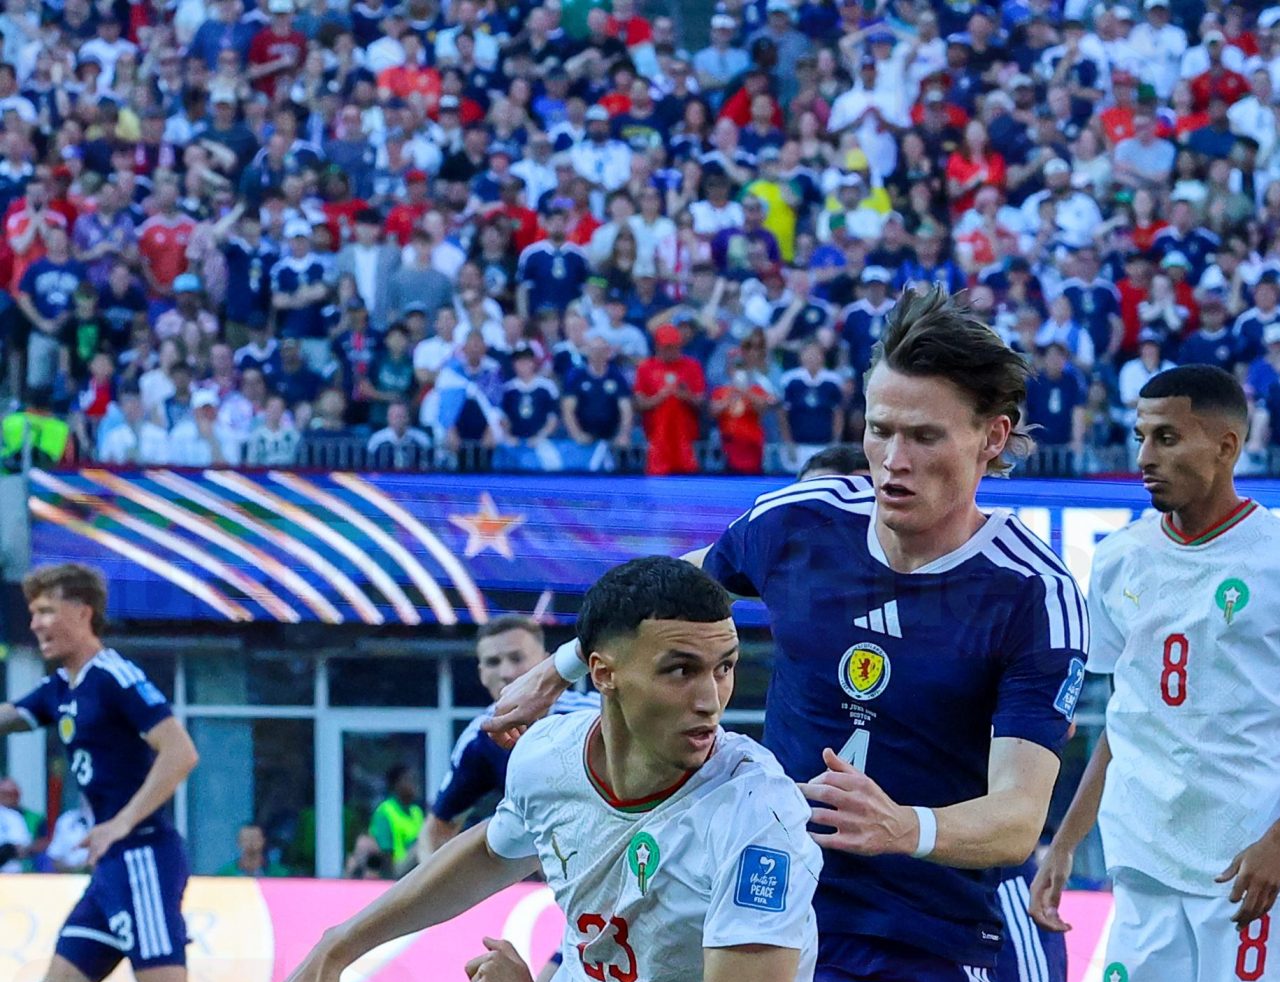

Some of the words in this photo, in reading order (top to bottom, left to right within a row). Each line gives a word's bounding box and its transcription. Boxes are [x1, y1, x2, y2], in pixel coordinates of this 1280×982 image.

[1160, 632, 1190, 707] 8
[750, 884, 775, 898] PEACE
[1235, 911, 1271, 982] 8
